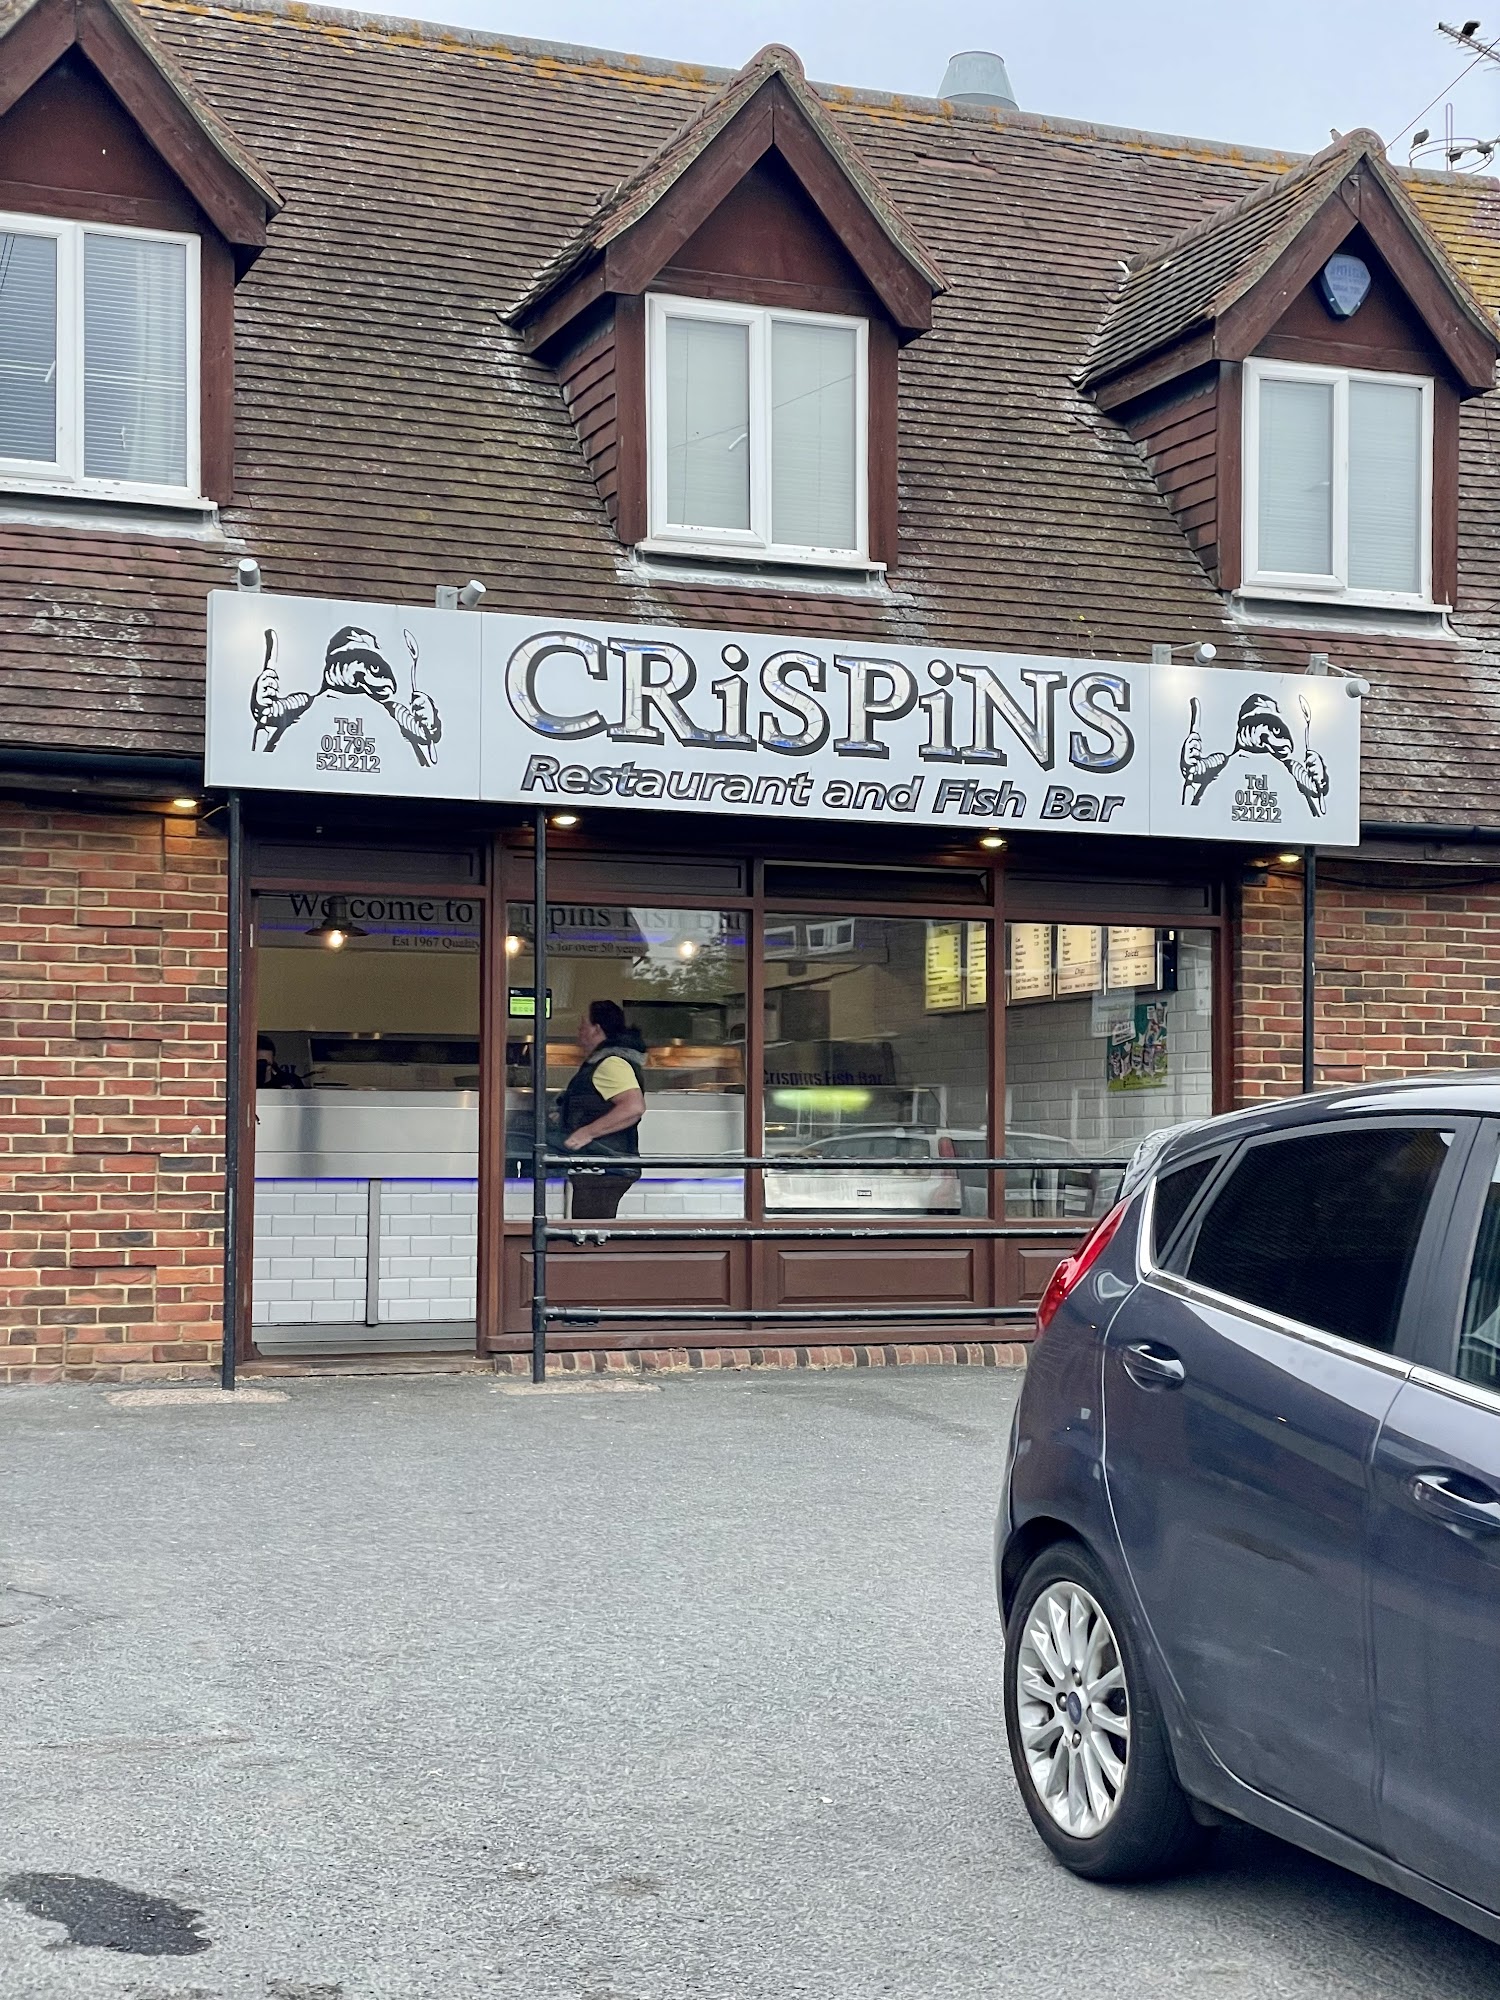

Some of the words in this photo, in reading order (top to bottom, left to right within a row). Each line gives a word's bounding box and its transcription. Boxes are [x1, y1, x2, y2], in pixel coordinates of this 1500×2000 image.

[334, 717, 363, 736] Tel
[321, 735, 376, 755] 01795
[316, 753, 380, 773] 521212
[521, 755, 815, 807] Restaurant
[822, 776, 925, 813] and
[932, 779, 1027, 818] Fish
[1039, 785, 1125, 822] Bar
[1244, 774, 1268, 790] Tel
[1235, 790, 1278, 807] 01795
[1232, 805, 1281, 823] 521212
[290, 894, 434, 920] Wecome
[446, 899, 473, 922] to
[392, 936, 409, 947] Est
[413, 937, 439, 948] 1967
[557, 943, 573, 952] for
[575, 944, 598, 953] over
[600, 942, 613, 953] 50
